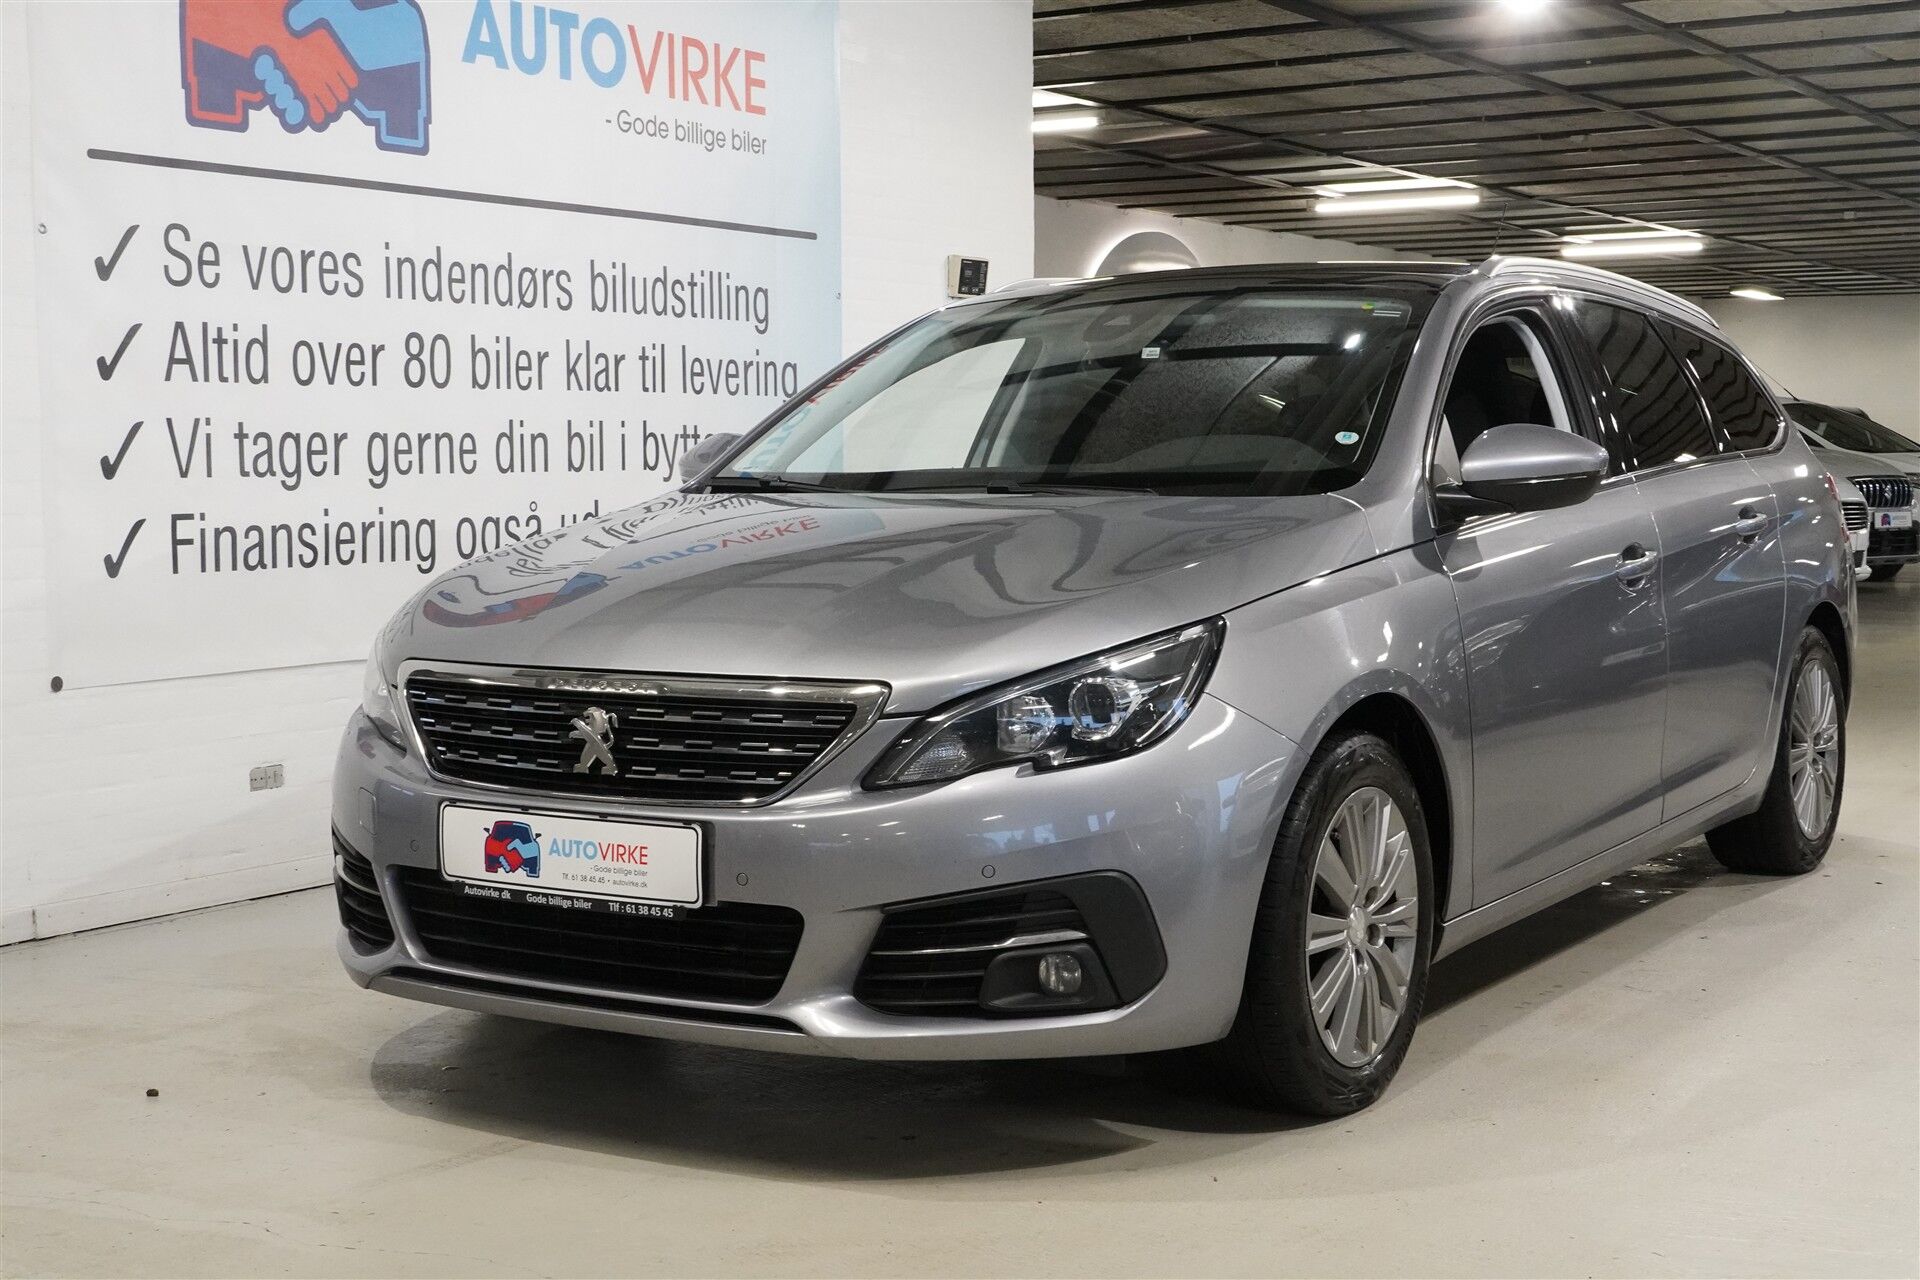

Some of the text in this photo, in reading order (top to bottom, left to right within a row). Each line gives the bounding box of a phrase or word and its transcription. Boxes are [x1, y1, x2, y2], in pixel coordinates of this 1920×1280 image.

[461, 0, 767, 116] AUTOVIRKE
[616, 108, 670, 140] Gode
[674, 118, 727, 153] billige
[731, 129, 767, 155] biler
[163, 223, 770, 335] Se vores indendørs biludstilling
[164, 321, 270, 385] Altid
[292, 338, 387, 388] over
[403, 331, 451, 390] 80
[470, 334, 551, 393] biler
[565, 339, 627, 394] klar
[638, 342, 667, 394] til
[681, 344, 799, 403] levering
[165, 417, 213, 479] Vi
[233, 421, 348, 492] tager
[367, 431, 477, 490] gerne
[495, 419, 549, 474] din
[567, 419, 605, 474] bil
[620, 419, 627, 472] i
[170, 512, 436, 575] Finansiering
[548, 837, 648, 866] AUTOVIRKE
[593, 864, 612, 874] Gode
[613, 866, 632, 877] billige
[633, 868, 648, 877] biler
[464, 885, 500, 899] Autovirke
[501, 889, 511, 900] dk
[526, 893, 547, 905] Gode
[548, 895, 572, 909] billige
[573, 899, 592, 910] biler
[625, 904, 637, 914] 61
[638, 905, 649, 915] 38
[650, 906, 661, 917] 45
[662, 908, 674, 918] 45
